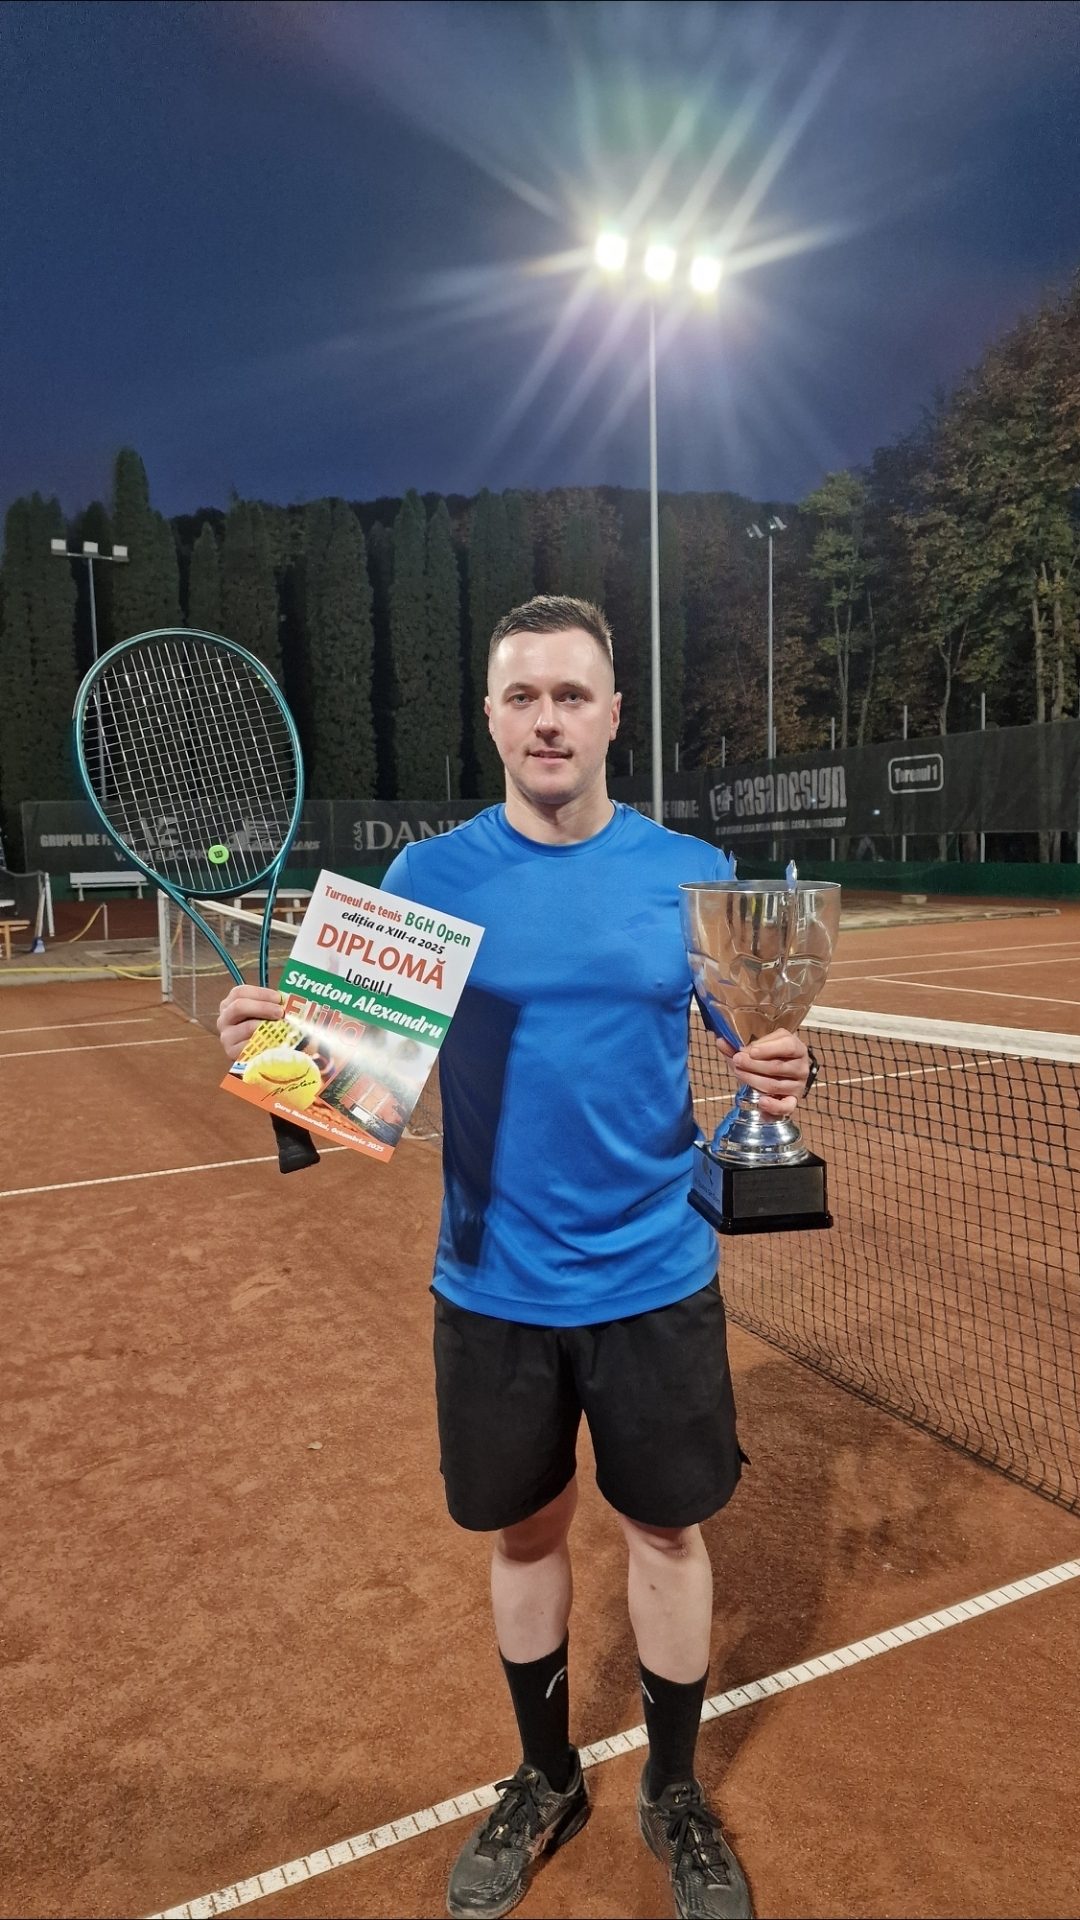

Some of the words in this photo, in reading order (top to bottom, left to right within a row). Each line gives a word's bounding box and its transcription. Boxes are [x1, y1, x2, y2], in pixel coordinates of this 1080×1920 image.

[40, 833, 84, 848] GRUPUL
[85, 833, 101, 846] DE
[324, 885, 363, 909] Turneul
[363, 900, 377, 913] de
[377, 905, 402, 923] tenis
[404, 911, 435, 934] BGH
[436, 923, 471, 948] Open
[375, 923, 384, 933] a
[384, 925, 417, 945] XIII-a
[417, 938, 446, 955] 2025
[316, 922, 447, 990] DIPLOMĂ
[344, 968, 384, 995] Locul
[285, 969, 353, 1006] Straton
[351, 995, 444, 1040] Alexandru
[366, 1140, 385, 1153] 2025
